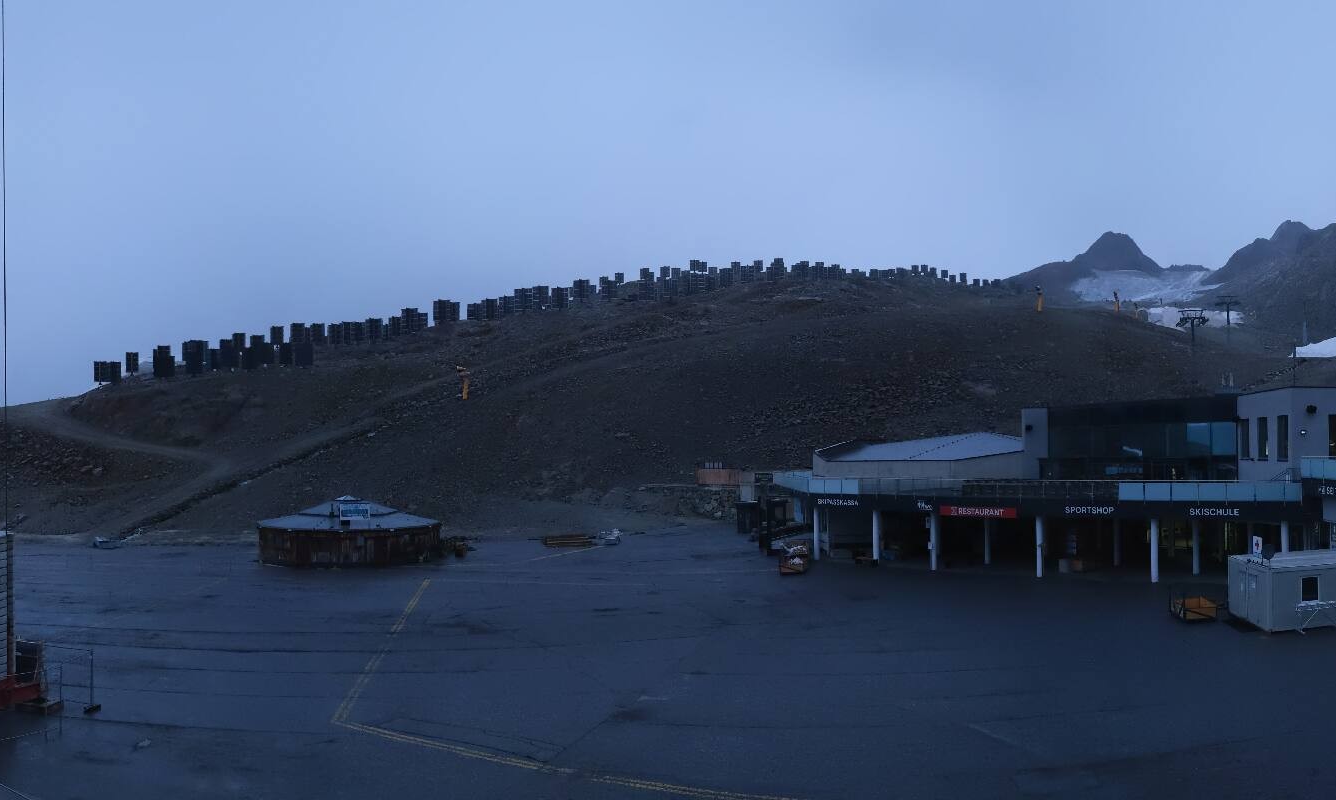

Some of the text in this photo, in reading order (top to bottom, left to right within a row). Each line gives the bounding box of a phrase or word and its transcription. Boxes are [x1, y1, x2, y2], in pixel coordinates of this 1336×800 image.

[958, 506, 1005, 517] RESTAURANT
[1065, 505, 1115, 515] SPORTSHOP
[1189, 507, 1240, 516] SKISCHULE
